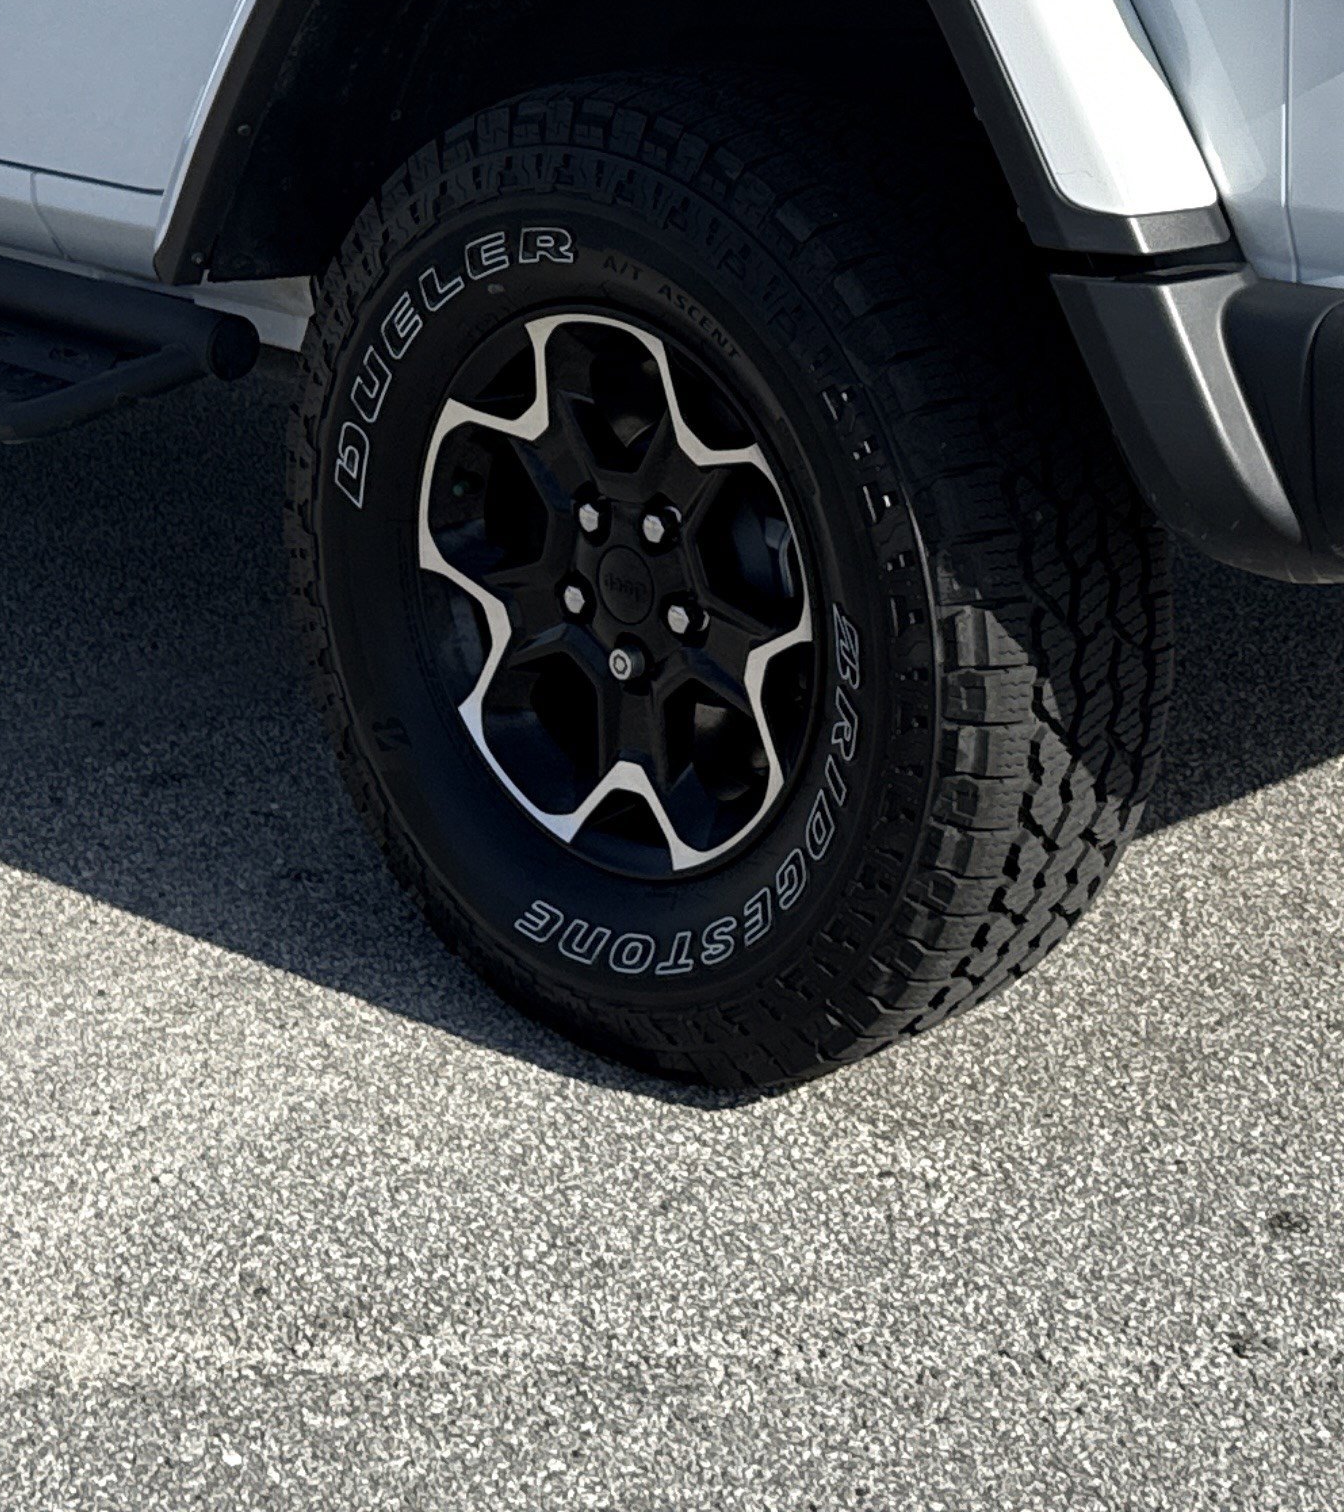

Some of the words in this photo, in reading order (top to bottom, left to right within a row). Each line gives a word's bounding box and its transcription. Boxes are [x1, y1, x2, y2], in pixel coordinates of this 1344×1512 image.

[334, 226, 574, 509] DUELER
[602, 255, 643, 282] A/T
[656, 283, 742, 362] ASCENT
[514, 603, 860, 975] BRIDGESTONE
